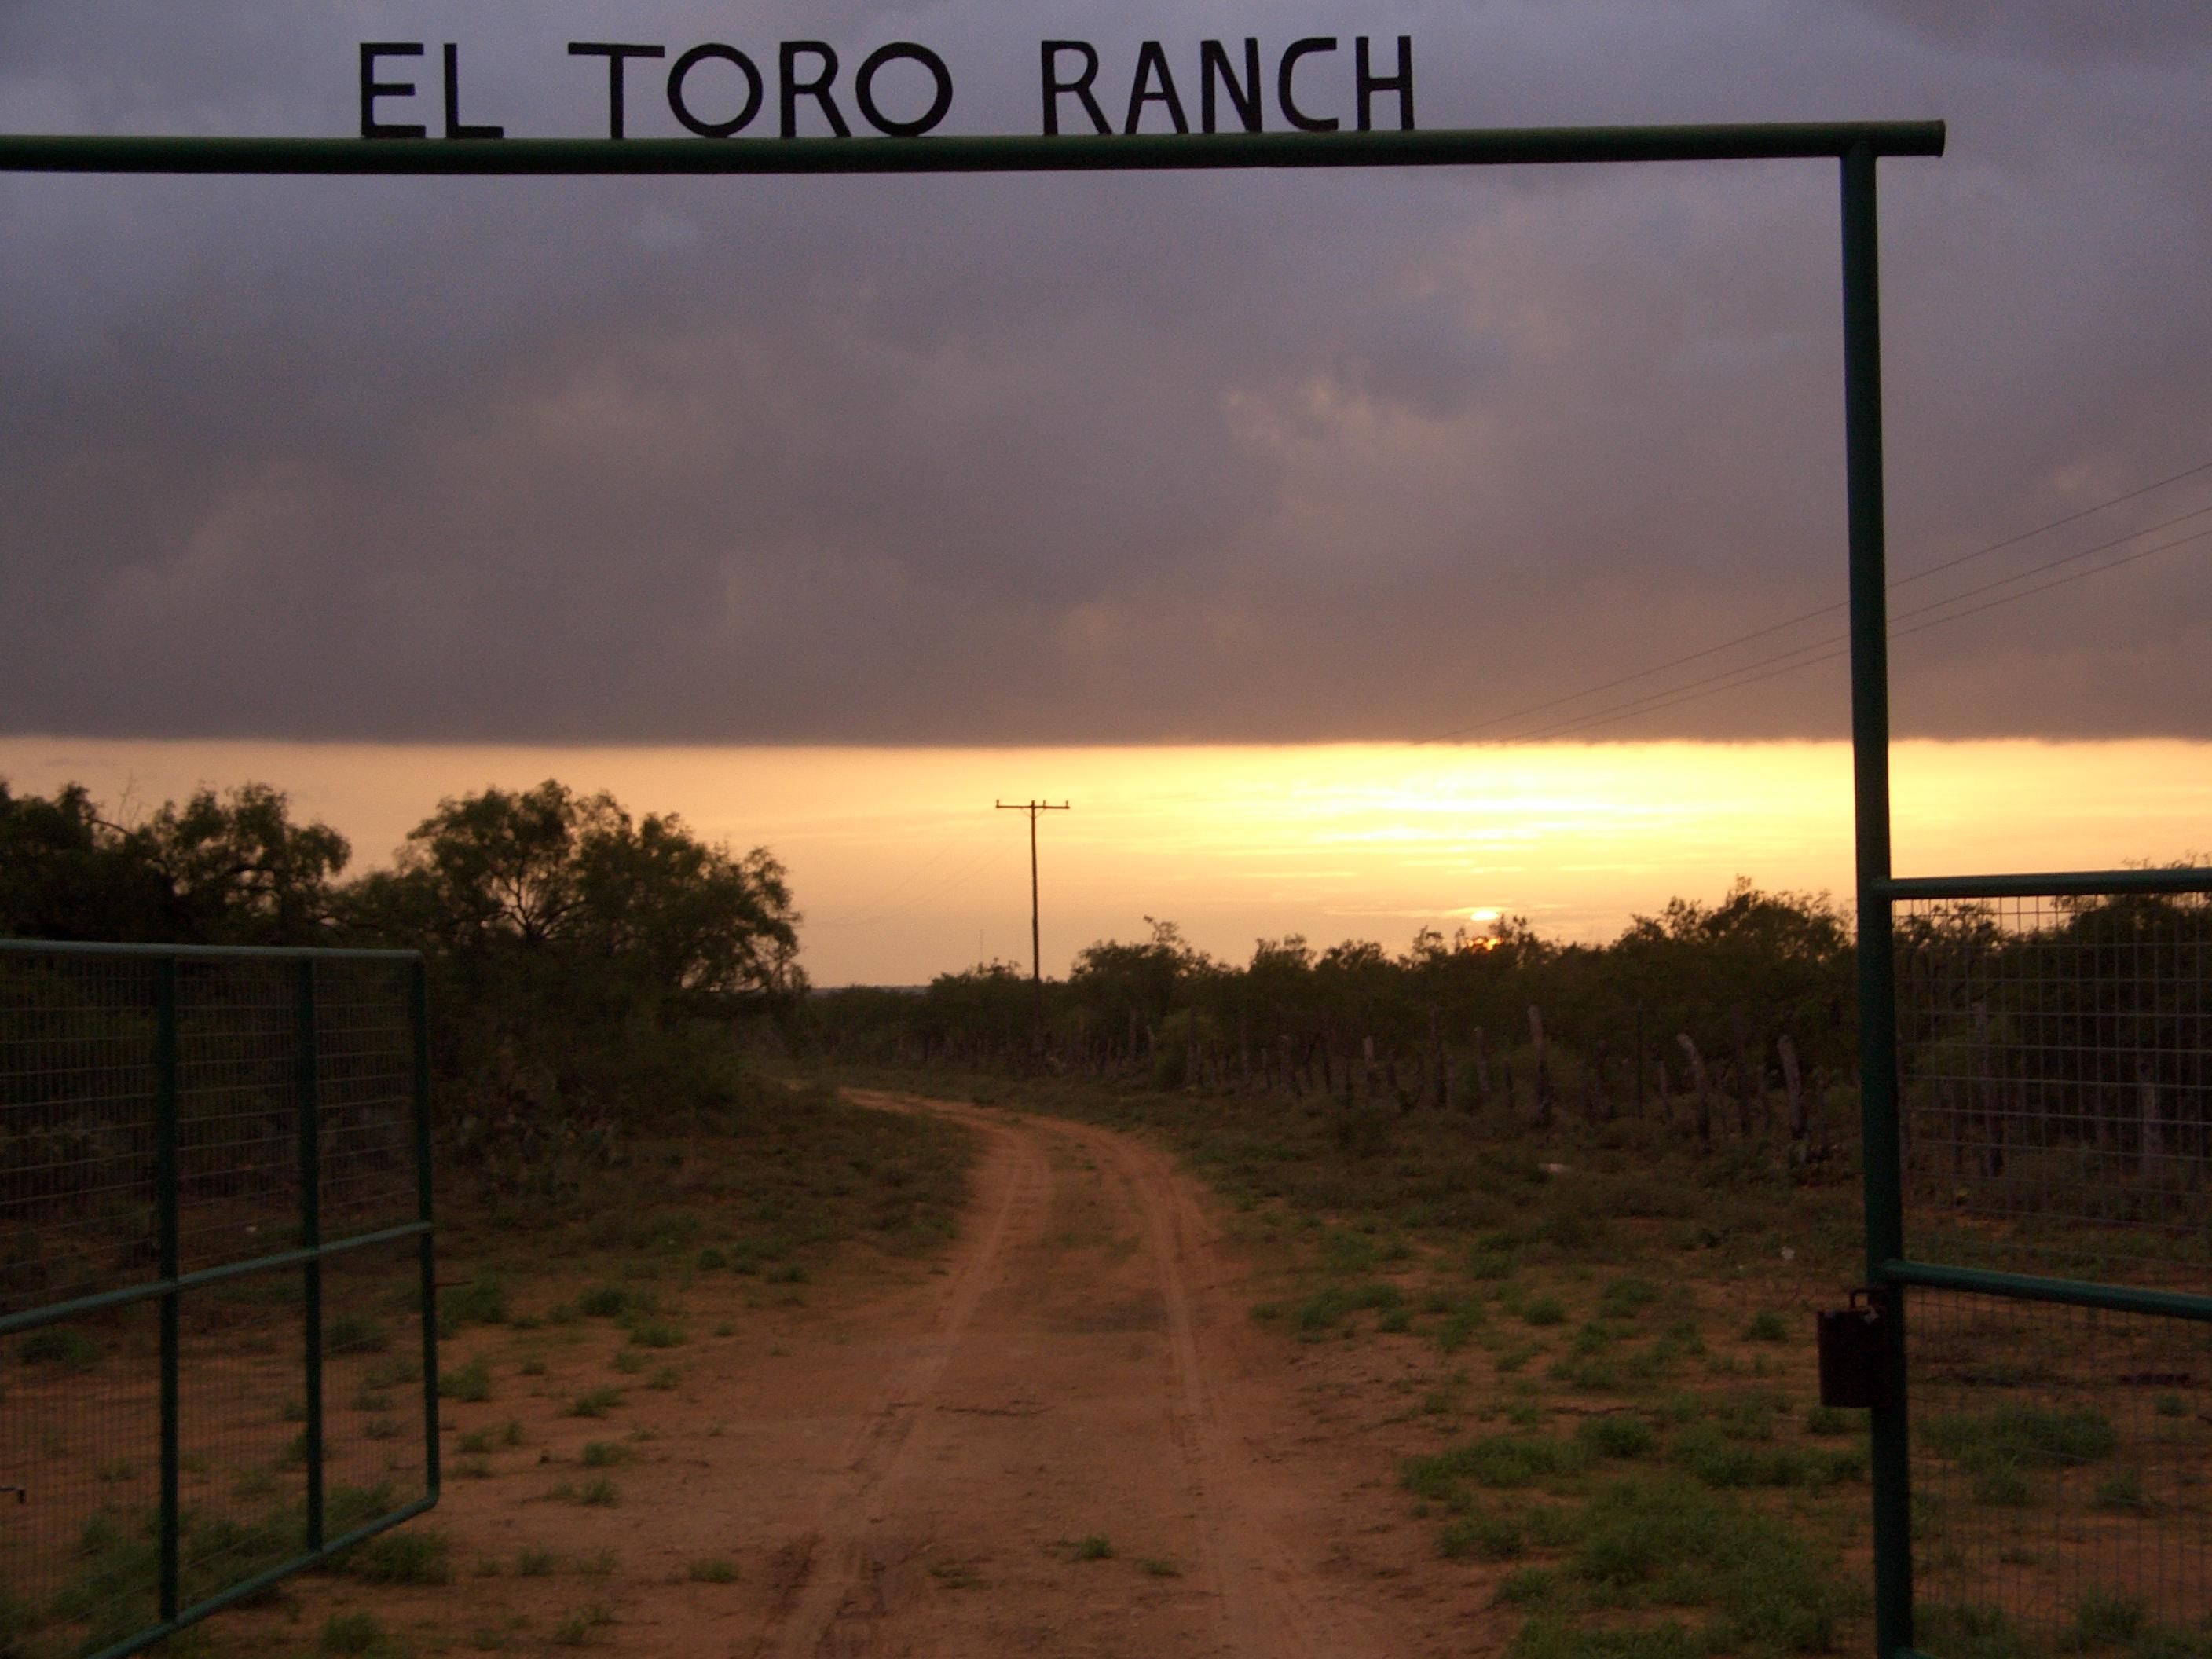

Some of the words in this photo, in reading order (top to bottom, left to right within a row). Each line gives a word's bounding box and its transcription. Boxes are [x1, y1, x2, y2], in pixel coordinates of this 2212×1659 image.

[360, 43, 504, 138] EL
[567, 41, 953, 139] TORO
[1042, 35, 1415, 135] RANCH
